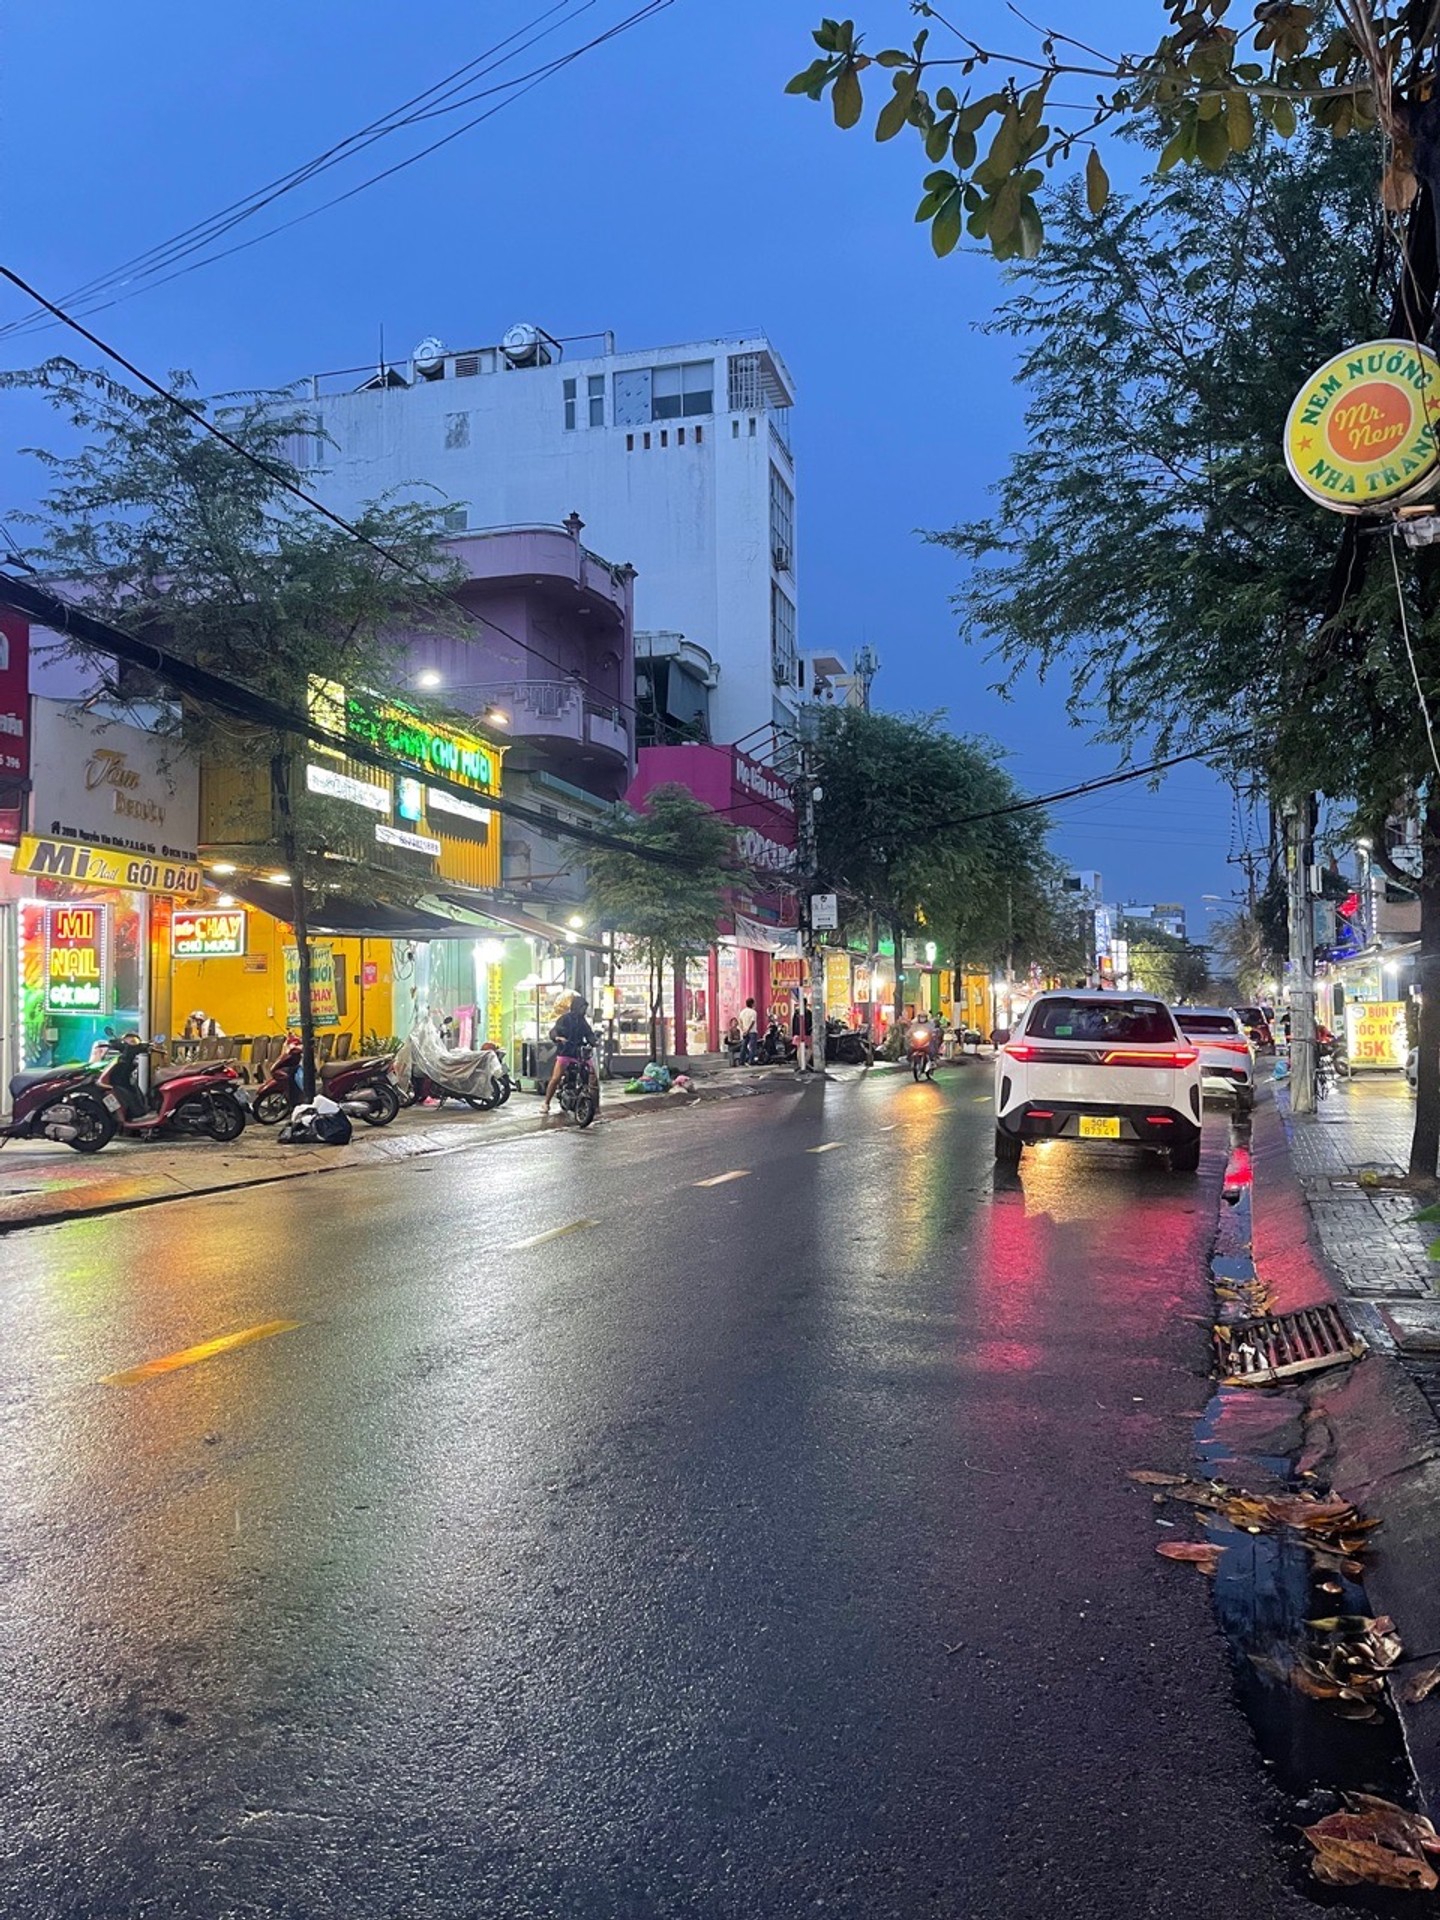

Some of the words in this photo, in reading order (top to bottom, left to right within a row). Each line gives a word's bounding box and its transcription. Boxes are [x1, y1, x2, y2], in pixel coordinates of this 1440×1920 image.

[1301, 375, 1342, 426] NEM
[1347, 351, 1434, 391] NƯỚNG
[1335, 402, 1386, 431] Mr.
[1348, 421, 1404, 450] Nem
[1308, 459, 1356, 494] NHA
[1365, 424, 1437, 492] TRANG
[89, 858, 120, 882] Nail
[127, 860, 159, 890] GỘI
[164, 864, 199, 893] ĐẦU
[58, 910, 94, 938] MI
[195, 916, 241, 939] CHAY
[50, 948, 100, 978] NAIL
[1368, 1004, 1388, 1018] BÚN
